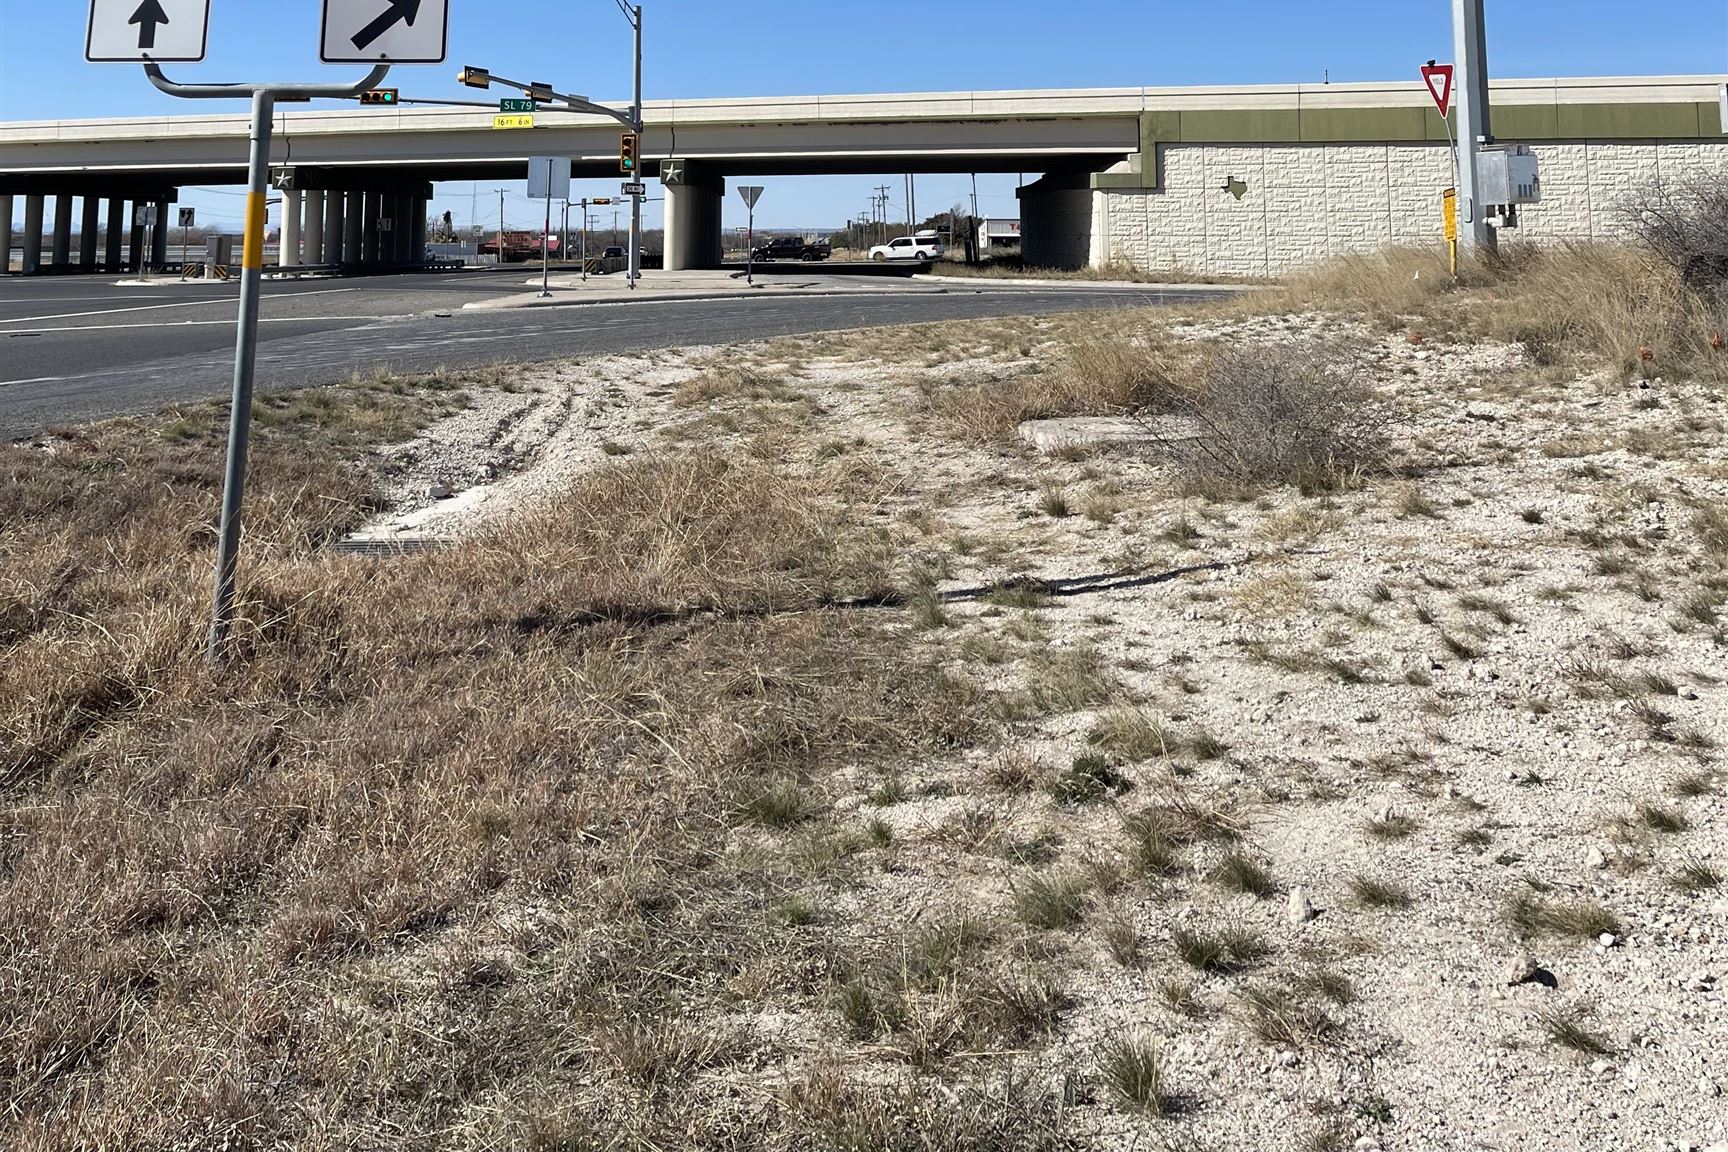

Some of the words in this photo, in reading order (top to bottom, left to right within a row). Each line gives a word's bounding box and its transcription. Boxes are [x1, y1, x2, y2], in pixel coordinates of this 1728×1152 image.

[504, 101, 515, 110] SL
[520, 101, 532, 110] 79
[497, 118, 505, 126] 16
[518, 118, 523, 126] 6
